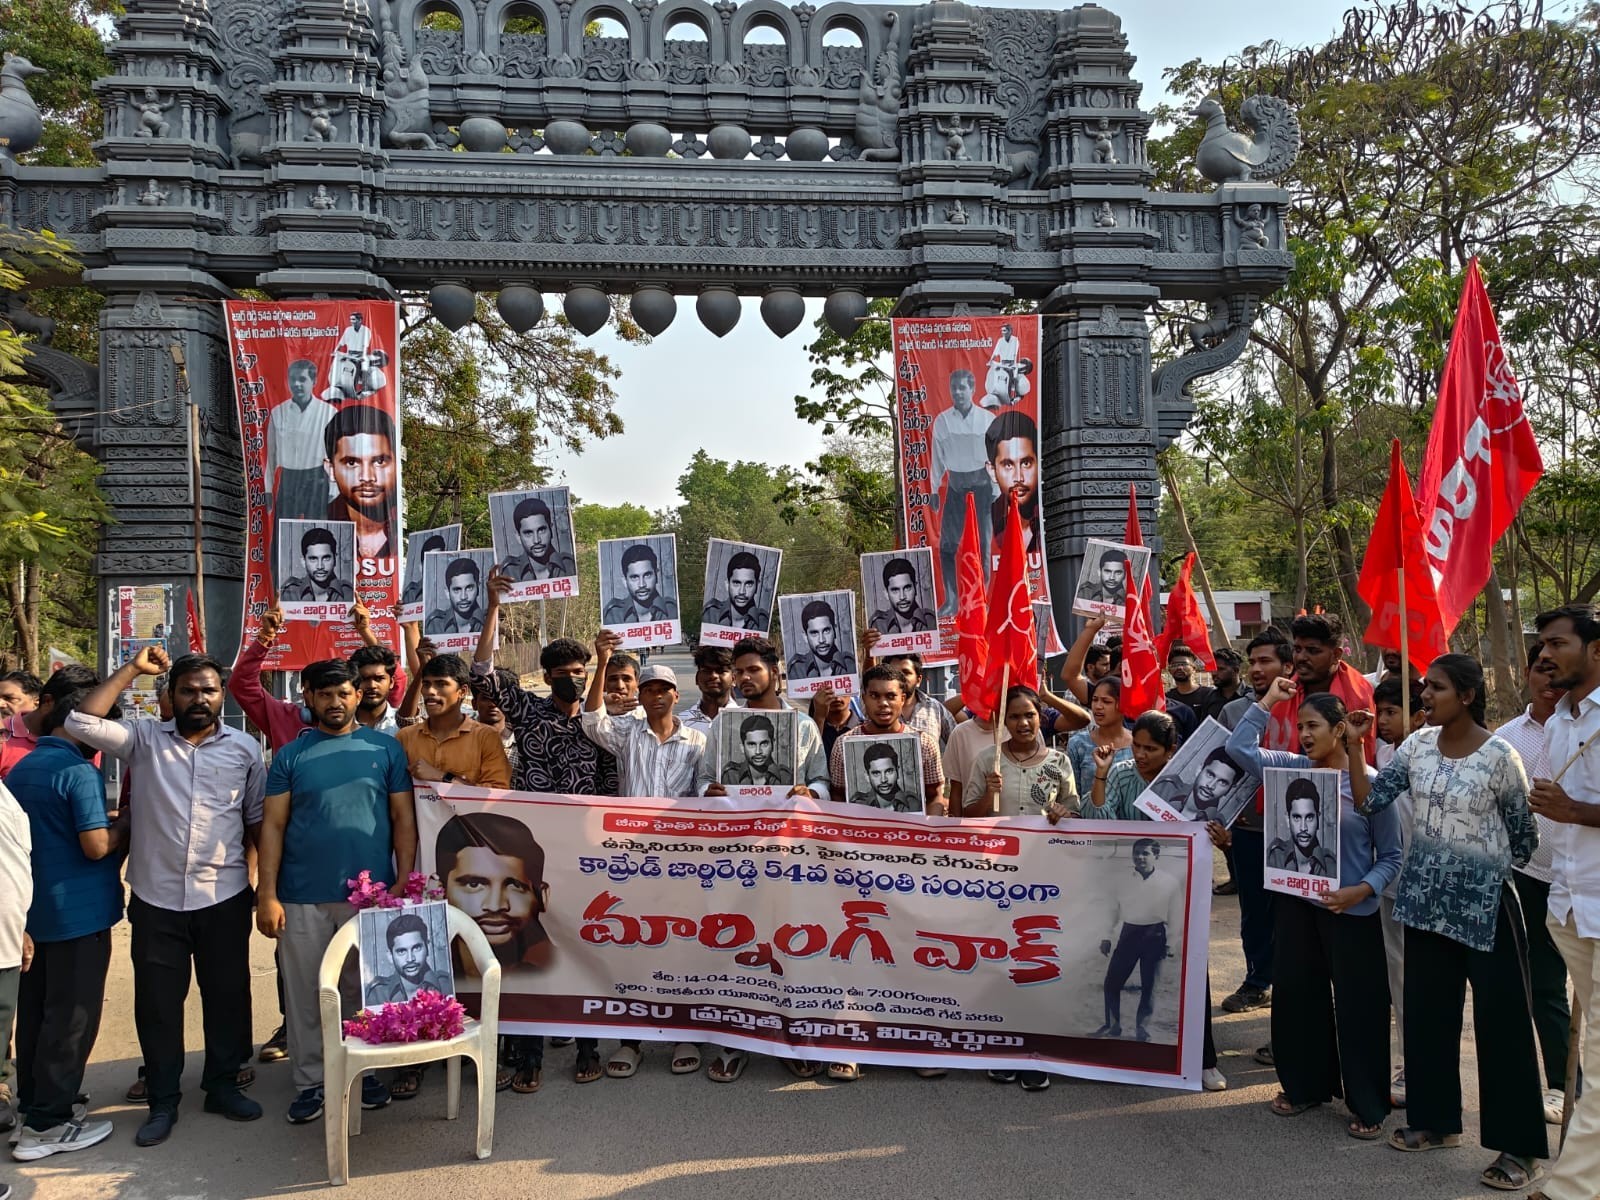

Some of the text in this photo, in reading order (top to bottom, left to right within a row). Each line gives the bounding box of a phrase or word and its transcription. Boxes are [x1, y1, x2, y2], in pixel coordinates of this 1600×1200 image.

[525, 583, 551, 599] జార్జి
[552, 578, 572, 597] రెడ్డి
[303, 605, 327, 620] జార్జి
[329, 603, 347, 620] రెడ్డి
[627, 621, 673, 641] జార్జి రెడ్డి
[891, 636, 914, 651] జార్జి
[915, 632, 932, 649] రెడ్డి
[835, 676, 852, 693] రెడ్డి
[801, 823, 839, 837] కదం
[843, 829, 880, 839] కదం
[601, 836, 704, 854] ఉస్మానియా
[816, 846, 928, 866] హైదరాబాద్
[932, 855, 1019, 873] చేగువేరా
[579, 852, 662, 881] కామ్రేడ్
[667, 859, 759, 889] జార్జిరెడ్డి
[764, 860, 828, 885] 54వ
[1286, 876, 1310, 897] జార్జి
[579, 890, 1063, 985] మార్నింగ్ వాక్
[784, 983, 843, 996] సమయం
[656, 985, 715, 996] కాకతీయ
[795, 999, 819, 1010] 2వ
[821, 998, 845, 1011] గేట్
[847, 1002, 887, 1013] నుండి
[889, 1004, 936, 1018] మొదటి
[938, 1009, 963, 1022] గేట్
[964, 1012, 1004, 1024] వరకు
[583, 1000, 673, 1019] PDSU
[690, 1006, 783, 1030] ప్రస్తుత
[788, 1019, 870, 1042] పూర్వ
